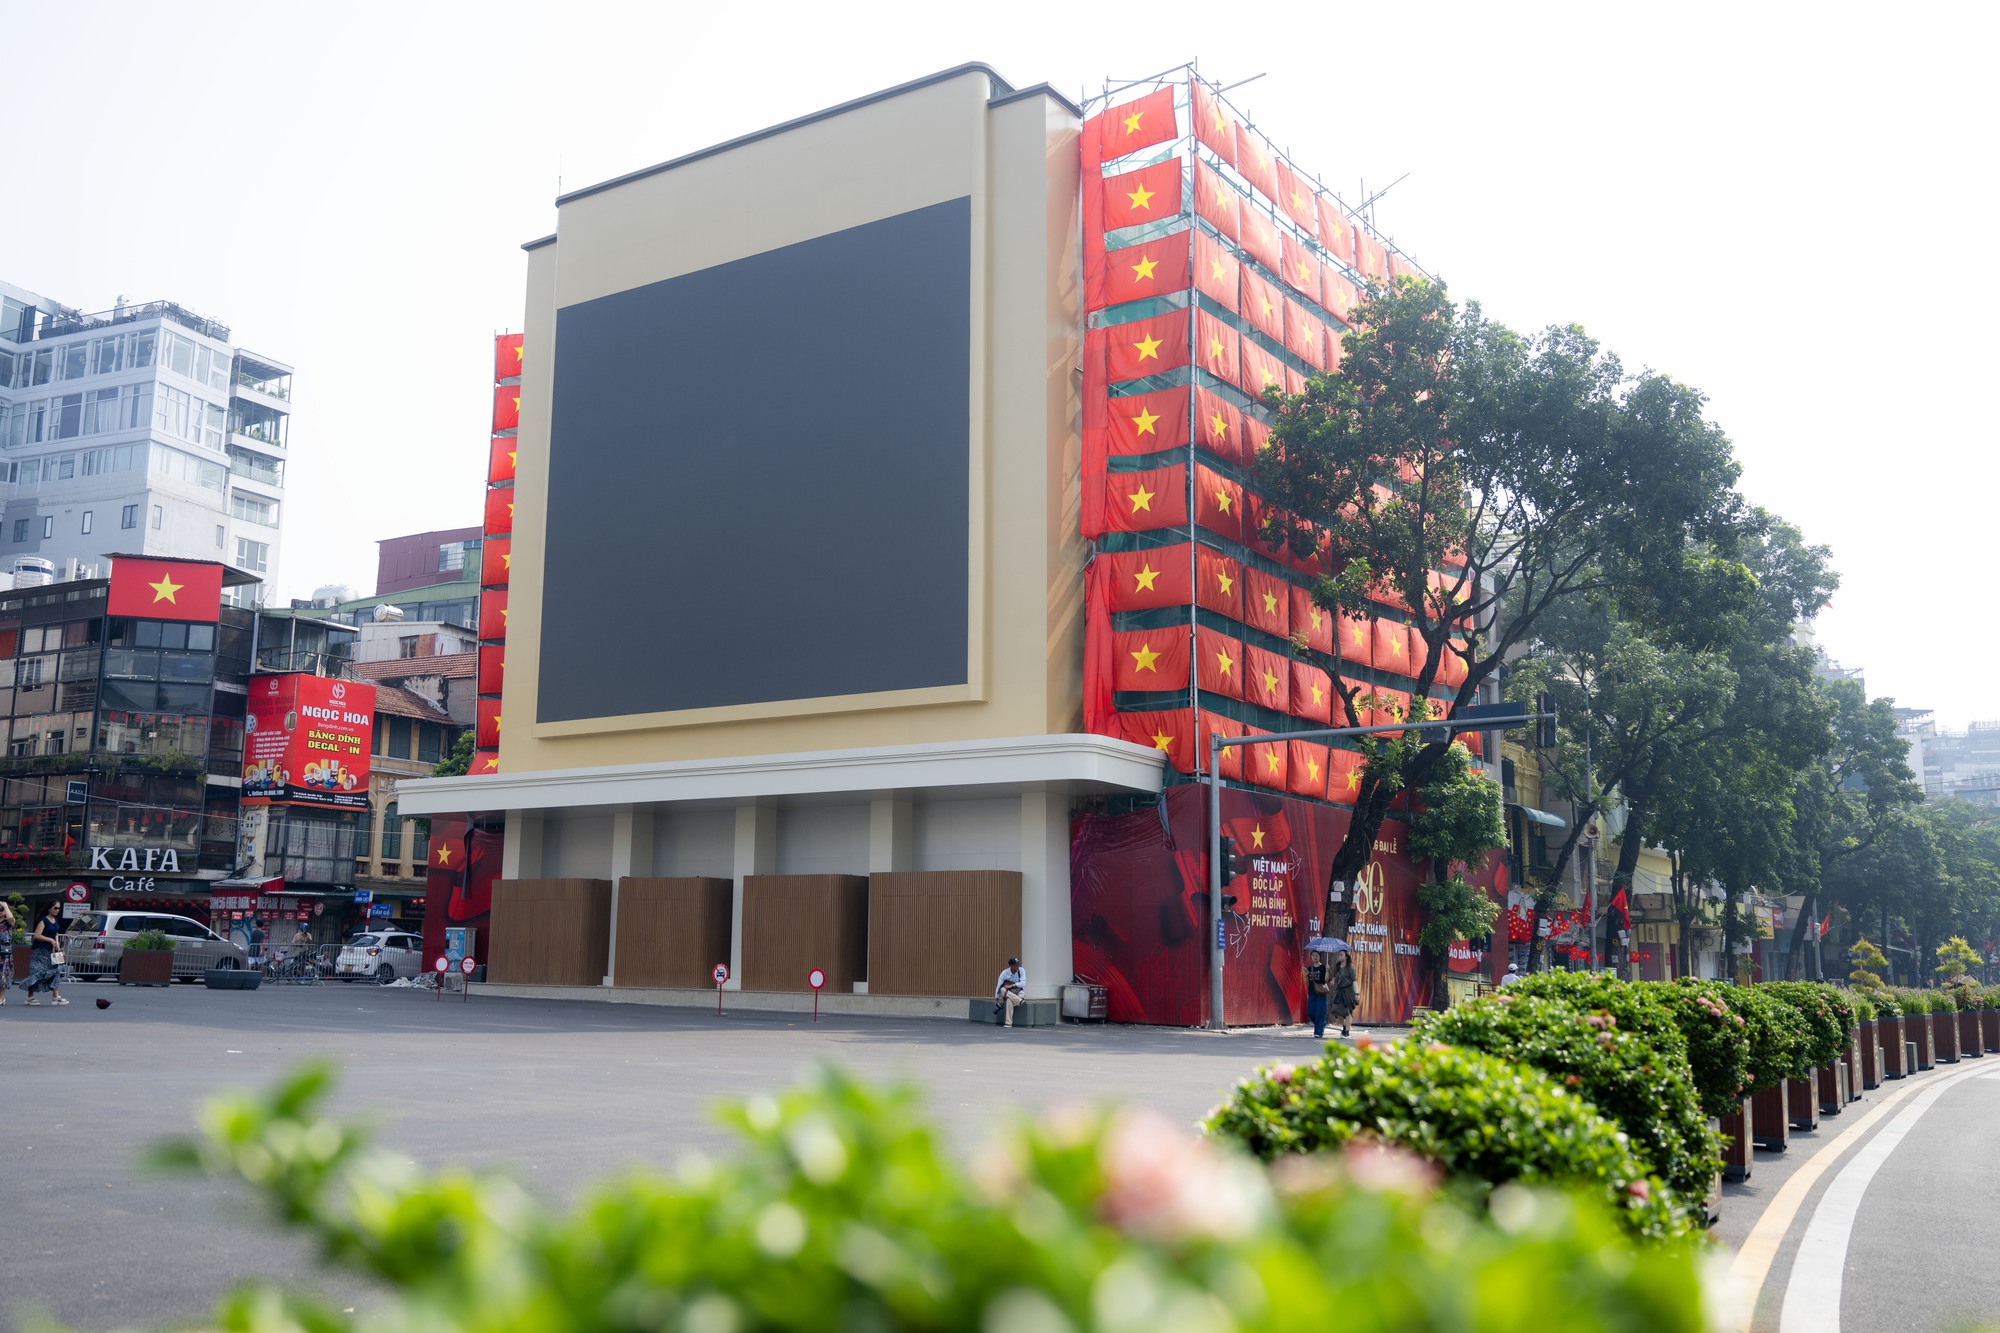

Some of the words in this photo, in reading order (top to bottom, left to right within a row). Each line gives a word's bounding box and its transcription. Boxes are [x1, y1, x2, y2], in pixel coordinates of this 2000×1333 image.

[302, 705, 340, 722] NGỌC
[343, 712, 369, 726] HOA
[308, 729, 335, 741] BĂNG
[338, 734, 361, 745] DÍNH
[308, 740, 339, 752] DECAL
[349, 746, 360, 754] IN
[1379, 841, 1389, 854] ĐẠI
[1390, 837, 1397, 854] LỄ
[89, 847, 181, 872] KAFA
[1253, 856, 1269, 875] VIỆT
[1271, 862, 1286, 874] NAM
[109, 876, 155, 892] Café
[1253, 875, 1267, 893] ĐỘC
[1269, 876, 1283, 894] LẬP
[1356, 862, 1384, 915] 80
[226, 897, 237, 909] FREE
[257, 897, 278, 909] REPAIR
[280, 898, 299, 910] PHONE
[1253, 894, 1267, 908] HOÀ
[1269, 896, 1286, 910] BÌNH
[1252, 911, 1270, 927] PHÁT
[1272, 912, 1292, 928] TRIỂN
[1310, 916, 1320, 931] TÔI
[1366, 921, 1387, 936] KHÁNH
[1401, 929, 1403, 939] I
[1354, 937, 1368, 954] VIỆT
[1369, 941, 1382, 953] NAM
[1394, 943, 1420, 955] VIETNAM
[1459, 946, 1470, 959] DÂN
